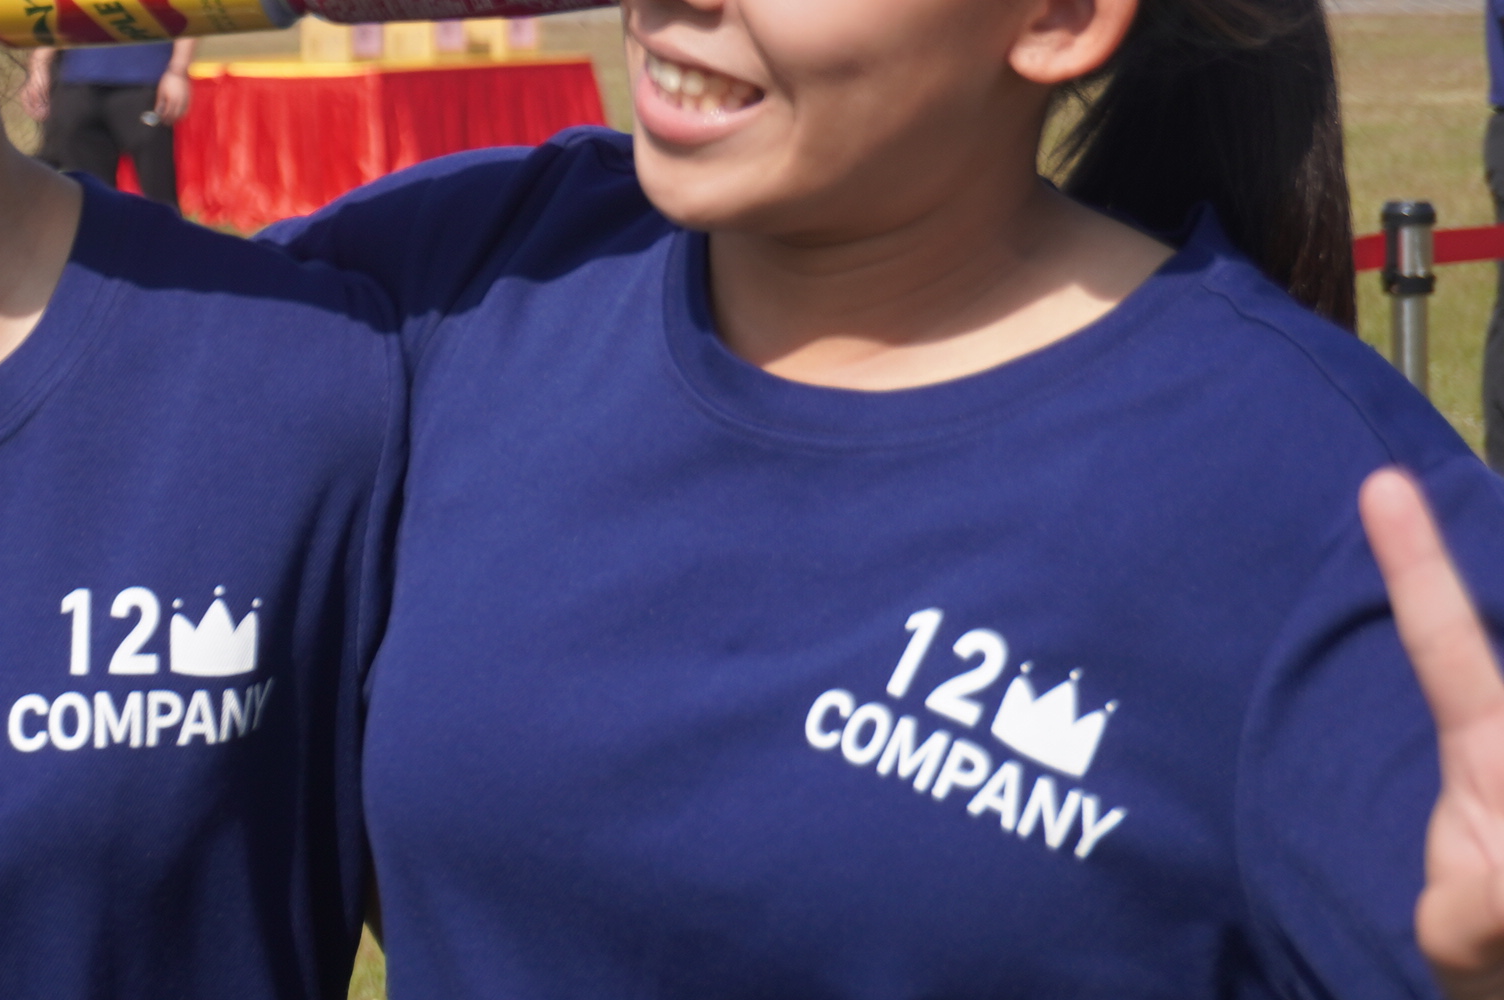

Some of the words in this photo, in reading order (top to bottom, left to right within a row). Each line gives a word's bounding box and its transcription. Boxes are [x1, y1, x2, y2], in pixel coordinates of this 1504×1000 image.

[61, 586, 161, 676] 12
[886, 606, 1009, 728] 12
[8, 676, 274, 752] COMPANY
[804, 687, 1127, 859] COMPANY
